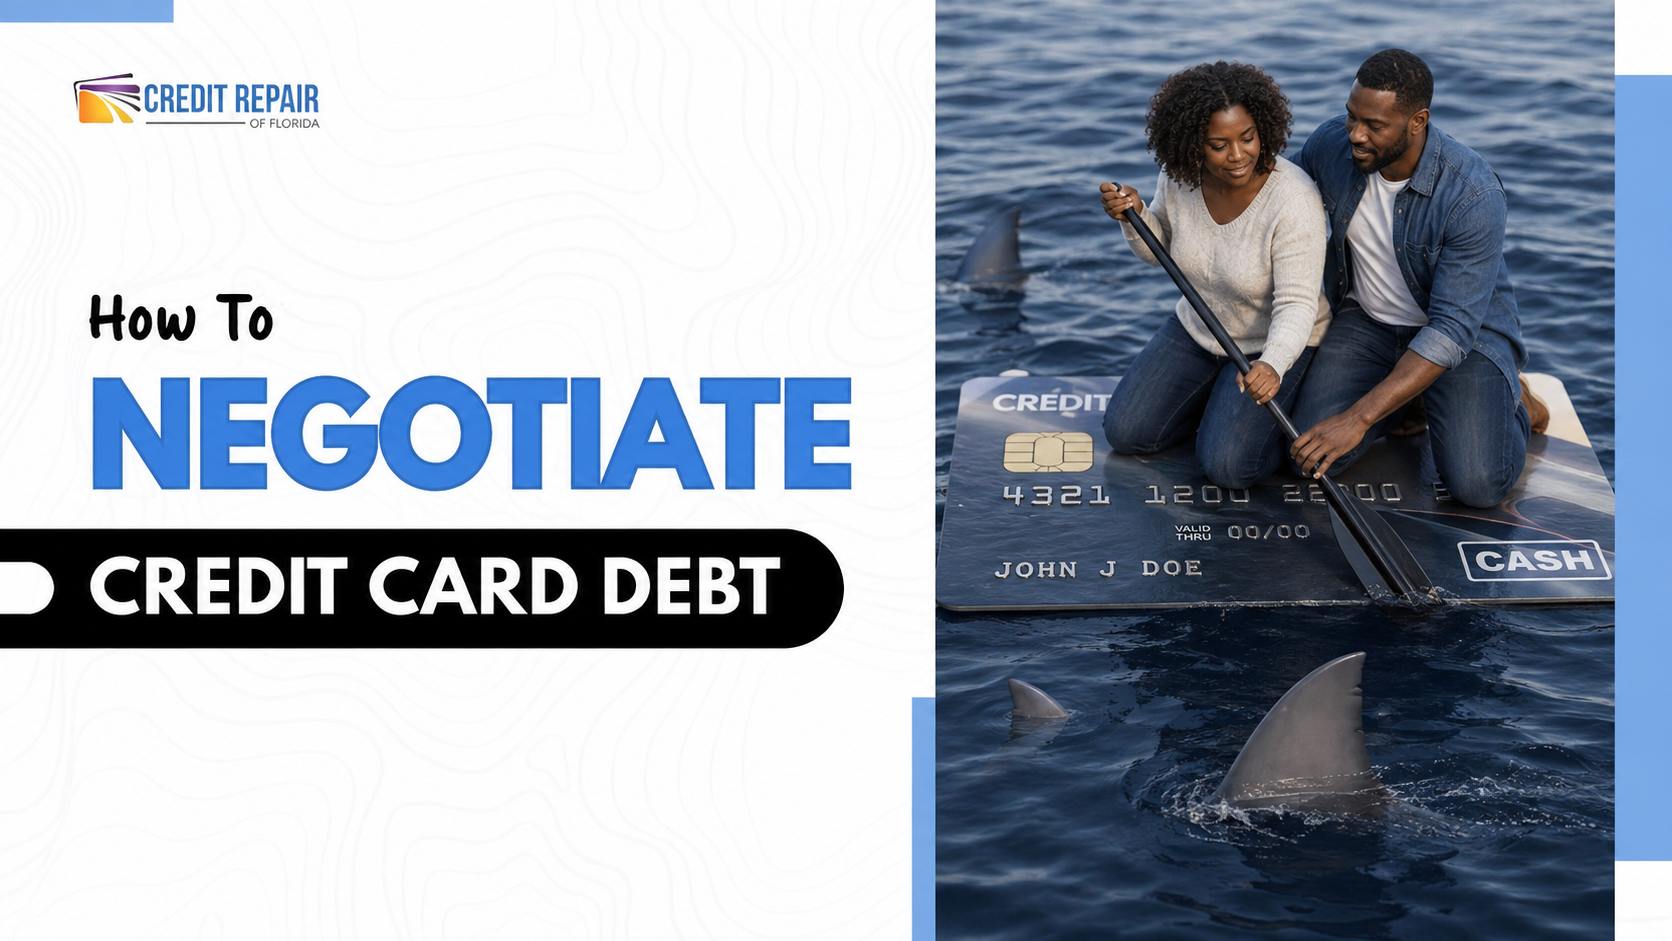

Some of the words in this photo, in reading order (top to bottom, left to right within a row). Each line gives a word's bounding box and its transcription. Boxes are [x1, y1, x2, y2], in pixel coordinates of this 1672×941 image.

[992, 394, 1113, 412] CREDIT
[1003, 485, 1111, 506] 4321
[1144, 484, 1250, 505] 1200
[1175, 533, 1212, 541] THRU
[1227, 524, 1311, 541] 00/00
[994, 561, 1077, 579] JOHN
[1099, 560, 1117, 577] J
[1141, 560, 1203, 577] DOE
[1475, 550, 1596, 572] CASH
